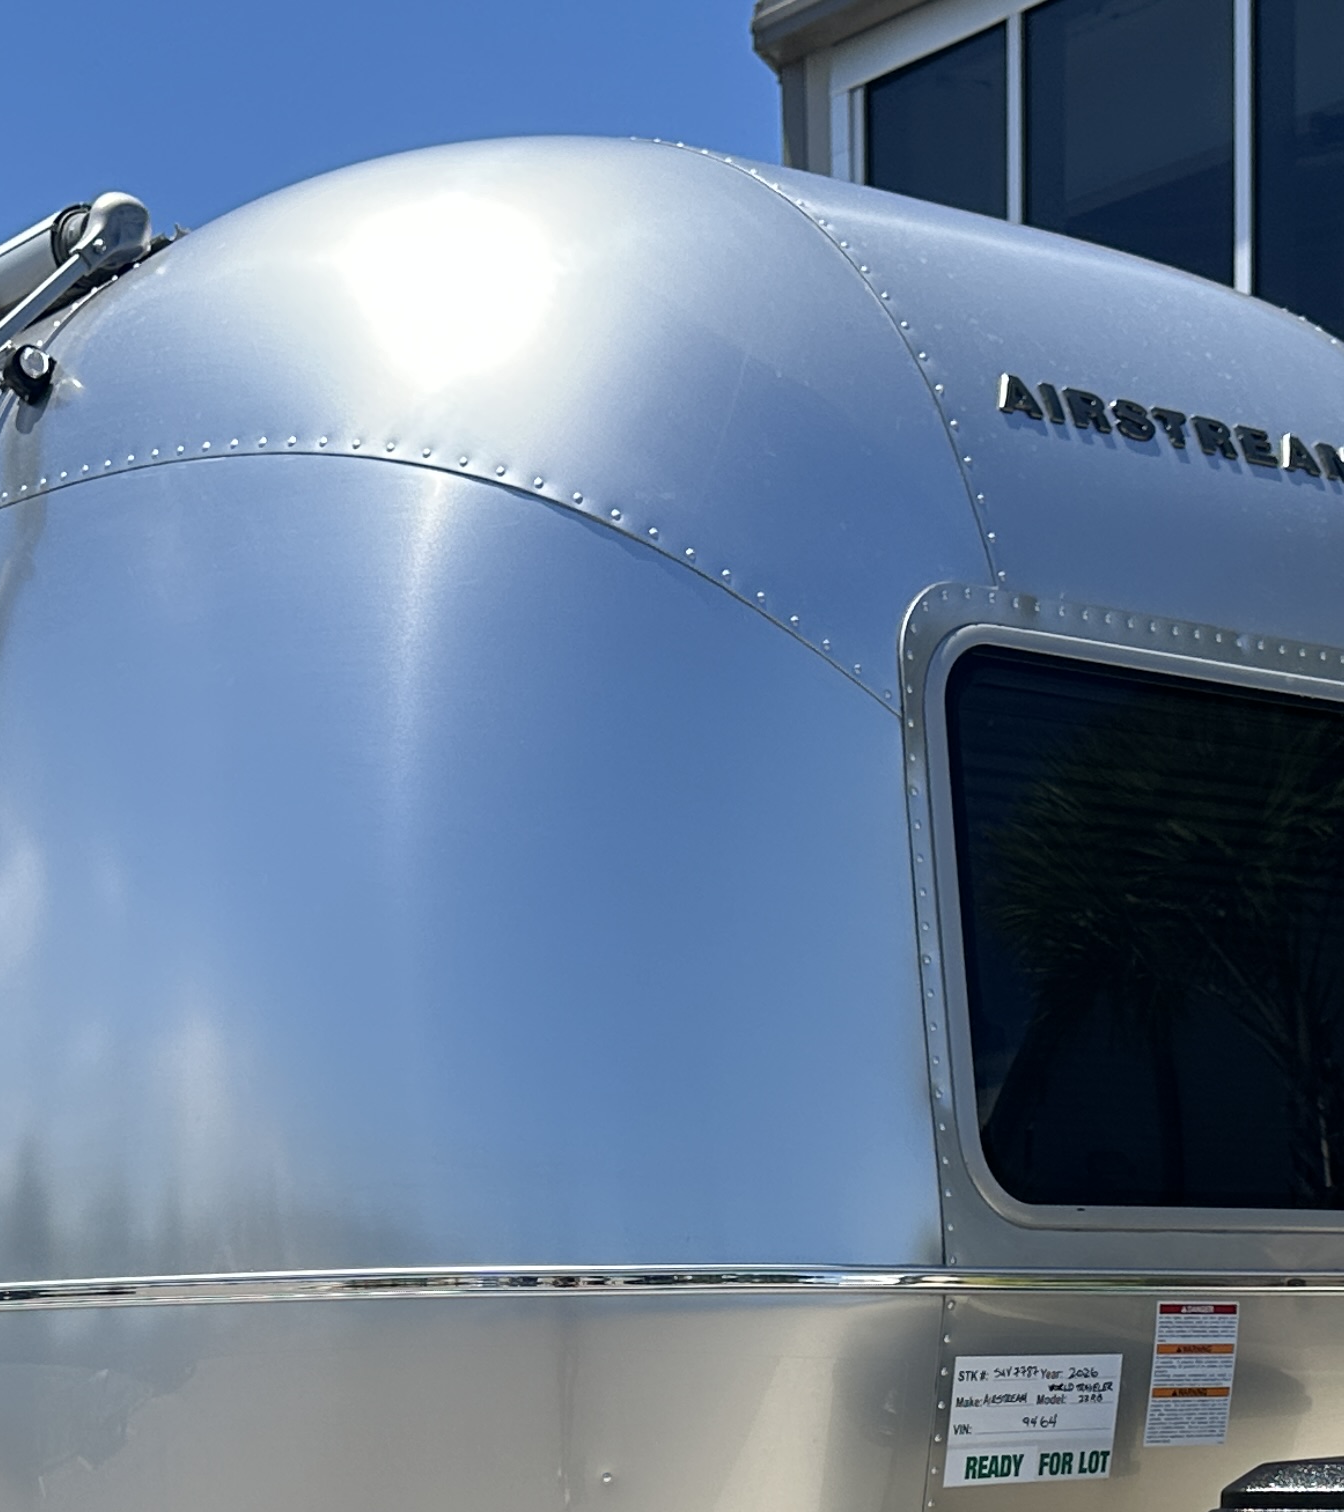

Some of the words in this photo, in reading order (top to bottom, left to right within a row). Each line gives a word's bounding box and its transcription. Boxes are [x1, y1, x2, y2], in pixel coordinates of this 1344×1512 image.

[1068, 1366, 1099, 1380] 2026
[953, 1424, 973, 1436] VIN:
[1022, 1414, 1058, 1428] 9464
[964, 1453, 1024, 1480] READY
[1038, 1451, 1074, 1476] FOR
[1078, 1450, 1110, 1474] LOT
